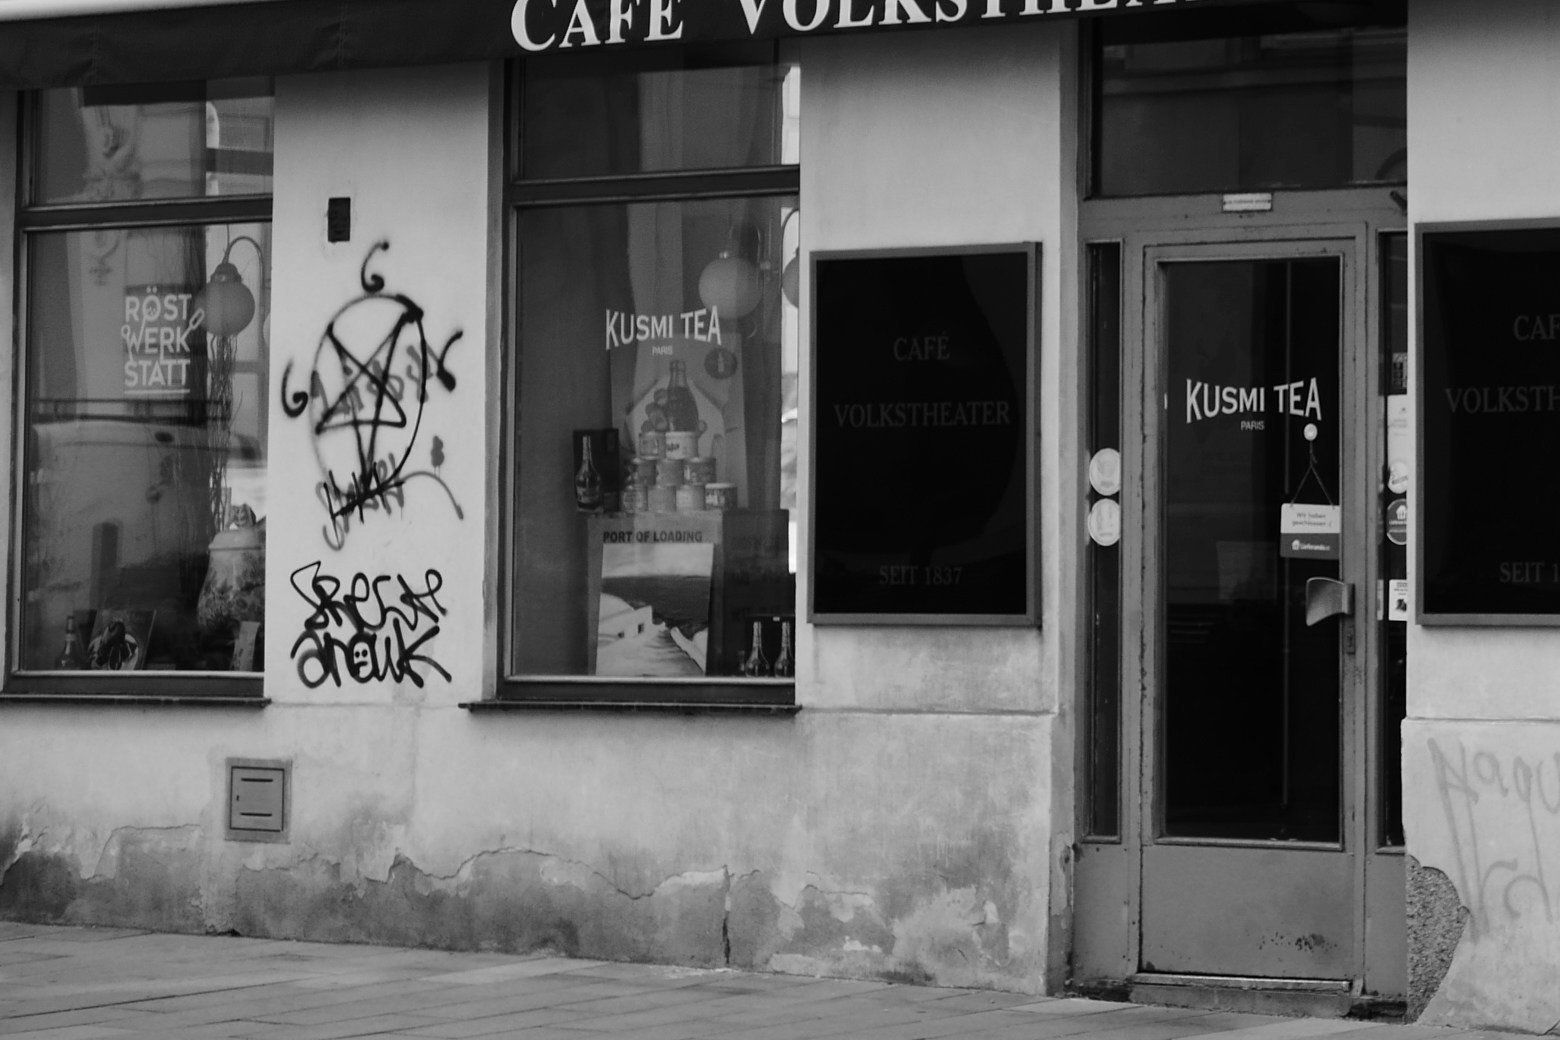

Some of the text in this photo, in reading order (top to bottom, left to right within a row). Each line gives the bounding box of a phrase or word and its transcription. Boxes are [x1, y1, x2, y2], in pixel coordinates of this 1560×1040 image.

[124, 285, 192, 322] RÖST
[125, 324, 191, 355] WERK
[605, 305, 722, 350] KUSMI TEA
[652, 345, 673, 356] PARIS
[893, 330, 951, 361] CAFÉ
[124, 359, 191, 388] STATT
[1186, 376, 1322, 424] KUSMI TEA
[834, 400, 1012, 430] VOLKSTHEATER
[1240, 420, 1265, 431] PARIS
[602, 530, 703, 543] PORT OF LOADING
[880, 564, 963, 586] SEIT 1837
[1499, 562, 1548, 585] SEIT
